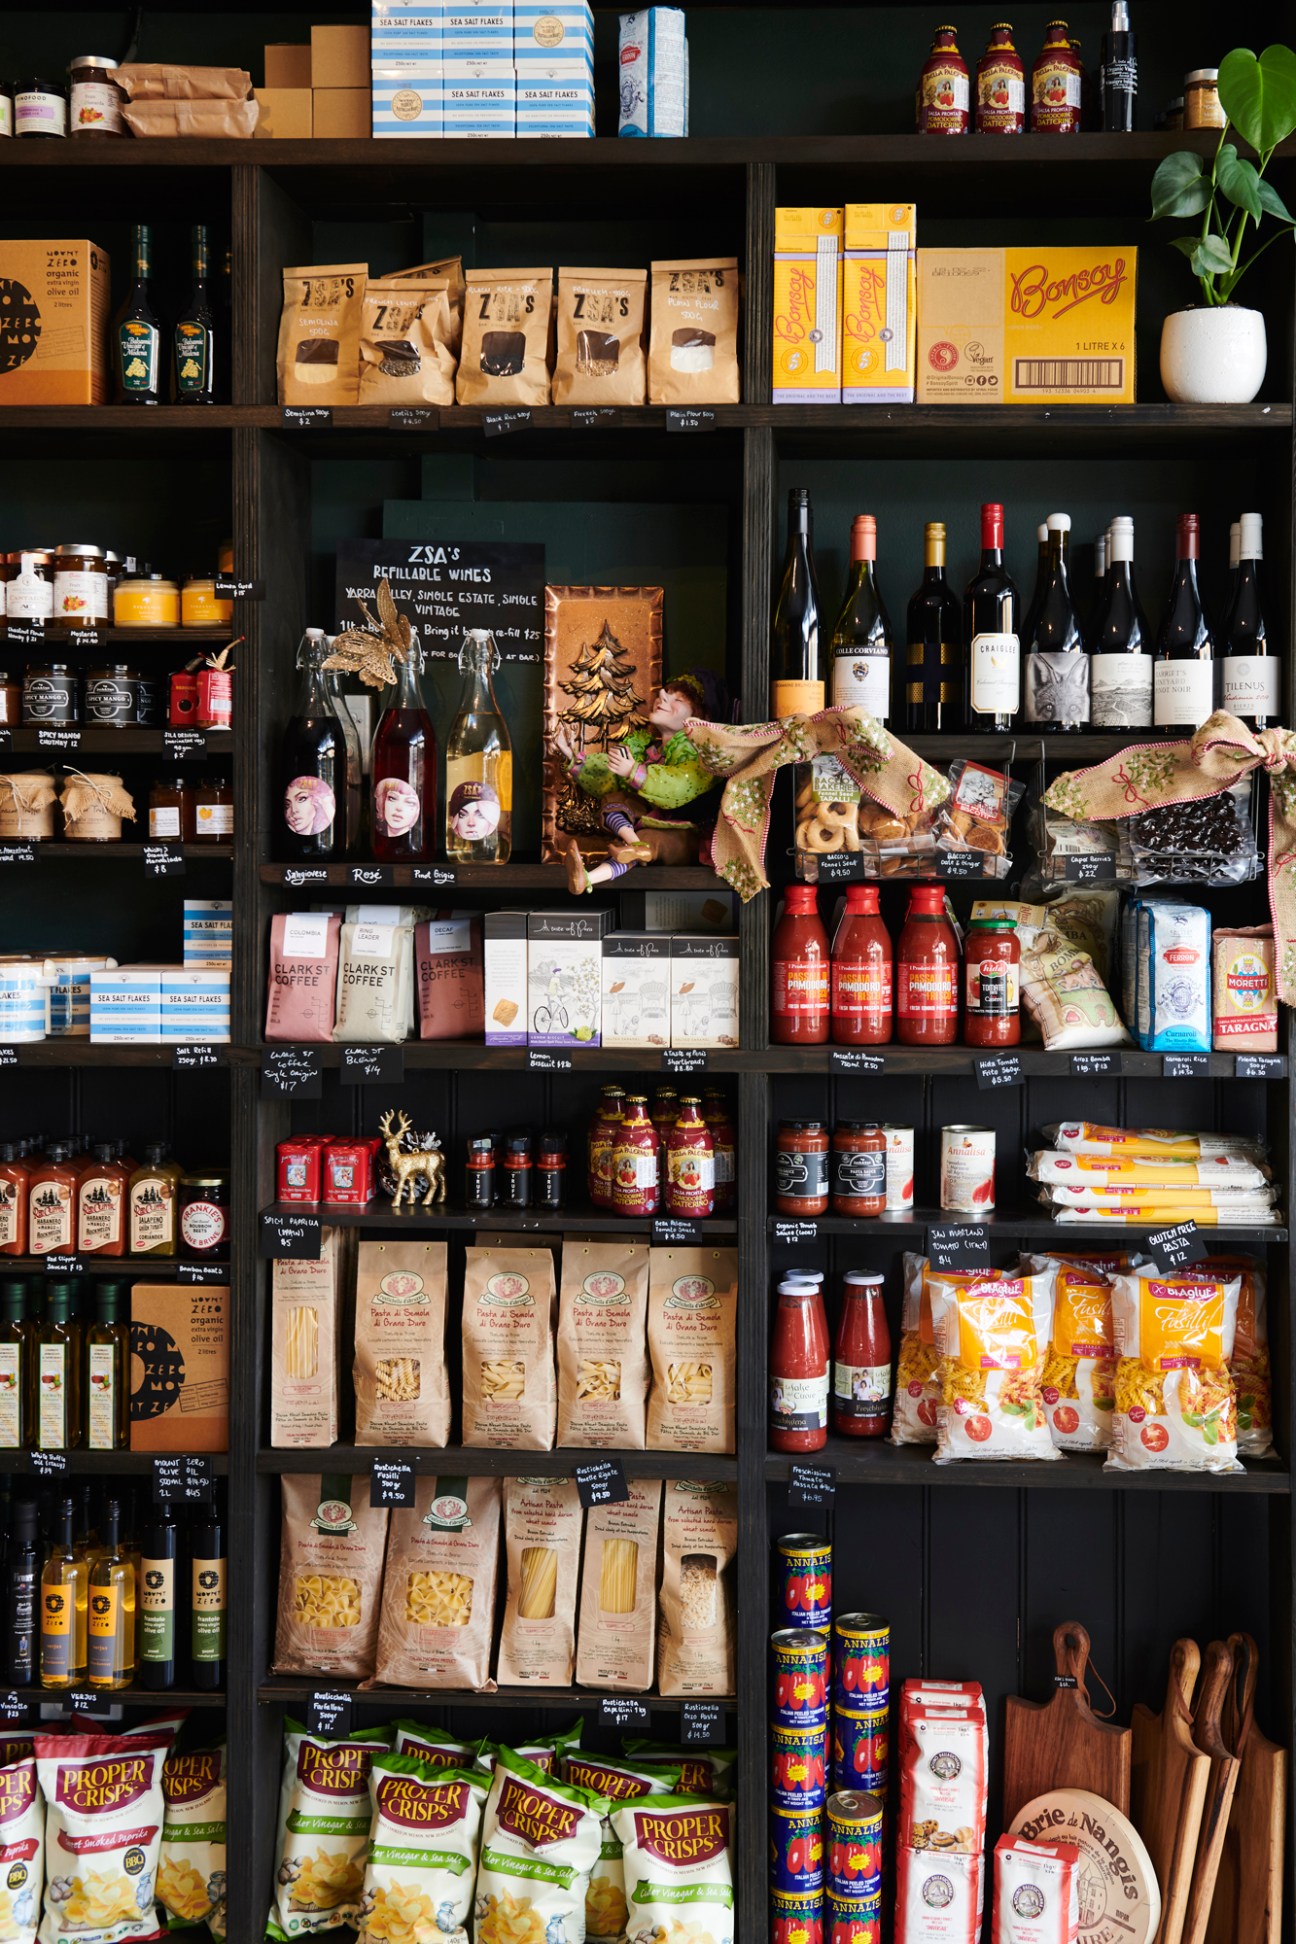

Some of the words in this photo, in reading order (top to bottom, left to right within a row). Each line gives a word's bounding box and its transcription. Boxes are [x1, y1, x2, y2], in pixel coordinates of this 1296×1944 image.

[380, 18, 394, 26] SEA
[396, 18, 409, 26] SALT
[411, 18, 433, 26] FLAKES
[452, 90, 465, 99] SEA
[467, 90, 480, 99] SALT
[482, 90, 504, 98] FLAKES
[47, 270, 79, 279] organic
[47, 288, 66, 296] olive
[1010, 258, 1128, 319] Bonsoy
[775, 267, 815, 344] Bonsoy
[846, 266, 886, 343] Bonsoy
[486, 415, 503, 423] Black
[374, 565, 441, 581] REFILLABLE
[449, 568, 491, 582] WINES
[346, 588, 376, 598] YARRA
[418, 590, 453, 602] SINGLE
[502, 594, 538, 606] SINGLE
[415, 604, 460, 617] VINTAGE
[854, 647, 888, 655] CORVIANO
[980, 645, 1016, 654] CRAIGLEE
[1225, 682, 1265, 691] TILENUS
[39, 730, 56, 739] SPICY
[58, 731, 81, 739] MANGO
[285, 869, 327, 885] Sangiovese
[352, 869, 382, 884] Rosé
[415, 870, 431, 879] Pinot
[434, 869, 455, 882] Grigio
[831, 869, 850, 877] $9.50
[1078, 870, 1096, 878] $22
[421, 960, 461, 970] CLARK
[462, 958, 475, 966] ST
[275, 964, 312, 975] CLARK
[315, 966, 330, 975] ST
[344, 963, 378, 973] CLARK
[380, 967, 395, 976] ST
[422, 969, 464, 981] COFFEE
[275, 976, 319, 986] COFFEE
[343, 975, 383, 986] COFFEE
[788, 980, 828, 990] POMODORO
[1229, 979, 1268, 987] MORETTI
[839, 982, 880, 991] POMODORO
[909, 982, 951, 992] POMODORO
[997, 1058, 1018, 1066] Tomate
[365, 1066, 380, 1075] $14
[992, 1075, 1012, 1084] $5.50
[280, 1082, 296, 1091] $17
[948, 1146, 985, 1156] Annalisa
[184, 1205, 220, 1223] FRANKIE'S
[1177, 1222, 1197, 1235] FREE
[184, 1230, 196, 1245] FINE
[199, 1231, 220, 1246] BRINE
[933, 1230, 945, 1239] SAN
[949, 1229, 983, 1237] MARZANO
[281, 1239, 291, 1247] $5
[933, 1242, 959, 1250] TOMATO
[1163, 1237, 1190, 1252] PASTA
[938, 1255, 952, 1265] $4
[1169, 1252, 1187, 1265] $12
[191, 1317, 223, 1325] organic
[663, 1311, 684, 1321] Pasta
[688, 1313, 694, 1321] di
[696, 1314, 721, 1322] Semola
[480, 1319, 487, 1327] di
[489, 1319, 511, 1328] Grano
[513, 1320, 530, 1329] Duro
[666, 1322, 673, 1330] di
[675, 1323, 697, 1331] Grano
[213, 1335, 223, 1343] oil
[186, 1468, 198, 1476] OIL
[577, 1463, 611, 1475] Rustichella
[599, 1469, 618, 1480] Rigate
[799, 1475, 823, 1483] Tomato
[382, 1492, 405, 1500] $9.50
[520, 1499, 542, 1508] Artisan
[546, 1501, 563, 1509] Pasta
[705, 1507, 723, 1515] Pasta
[8, 1695, 18, 1703] Fig
[616, 1714, 628, 1724] $17
[772, 1734, 824, 1745] ANNALISA
[64, 1760, 145, 1794] PROPER
[570, 1766, 642, 1798] PROPER
[381, 1780, 461, 1809] PROPER
[505, 1784, 574, 1834] PROPER
[642, 1814, 724, 1839] PROPER
[84, 1833, 117, 1848] Smoked
[118, 1830, 148, 1845] Paprika
[1018, 1809, 1065, 1840] Brie
[1067, 1812, 1078, 1827] de
[1081, 1812, 1138, 1900] Nangis
[125, 1856, 145, 1867] BBQ
[9, 1870, 27, 1882] BBQ
